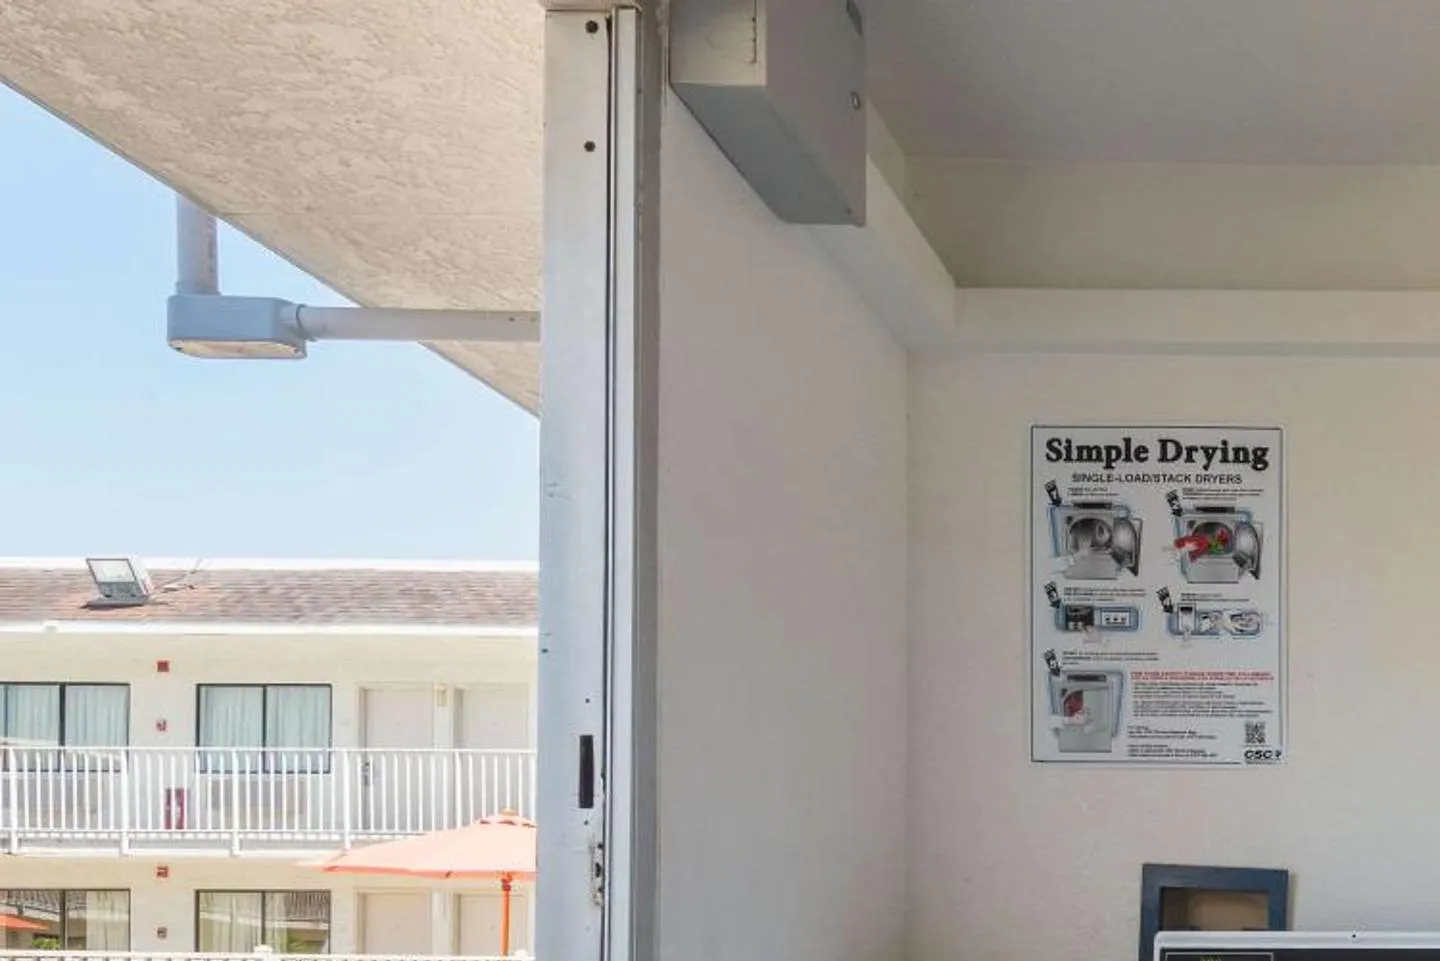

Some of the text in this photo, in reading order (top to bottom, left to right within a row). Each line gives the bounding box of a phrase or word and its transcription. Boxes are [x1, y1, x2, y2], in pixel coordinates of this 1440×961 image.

[1045, 437, 1270, 471] Simple Drying
[1195, 474, 1243, 484] DRYERS
[1244, 749, 1273, 760] CSC
